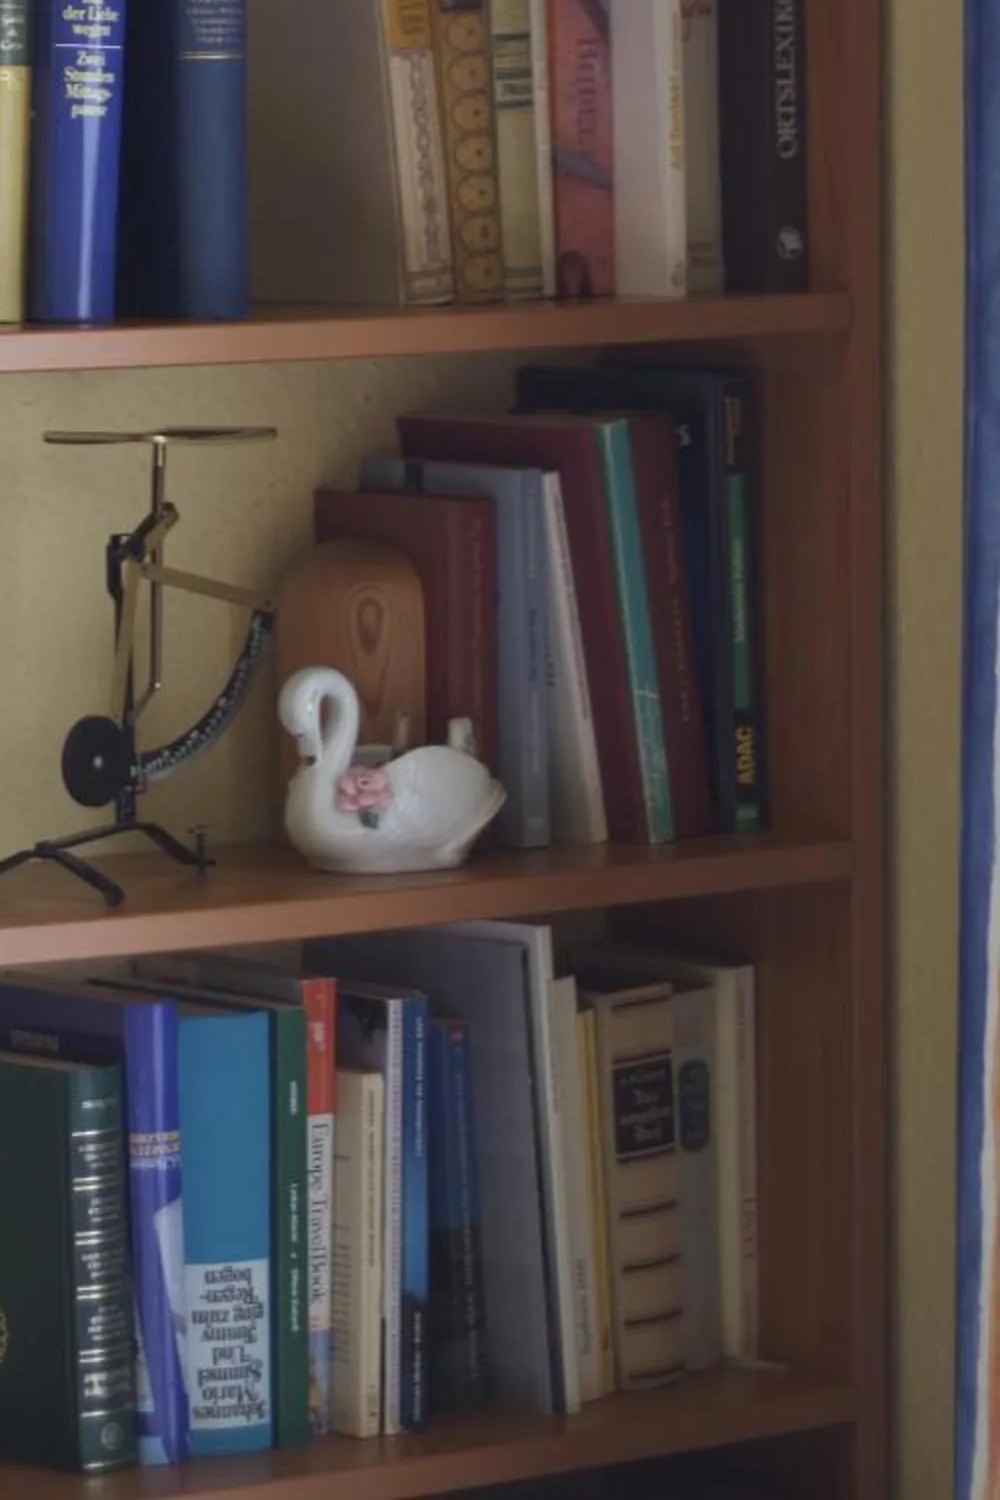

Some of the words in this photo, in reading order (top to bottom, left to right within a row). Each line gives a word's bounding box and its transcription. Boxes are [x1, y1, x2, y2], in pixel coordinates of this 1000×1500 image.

[734, 724, 755, 785] ADAC
[309, 1122, 329, 1192] Europe
[204, 1264, 253, 1287] bogen
[212, 1345, 252, 1366] Und
[197, 1360, 263, 1386] Simmel
[202, 1384, 259, 1403] Mario
[193, 1401, 267, 1423] Johannes
